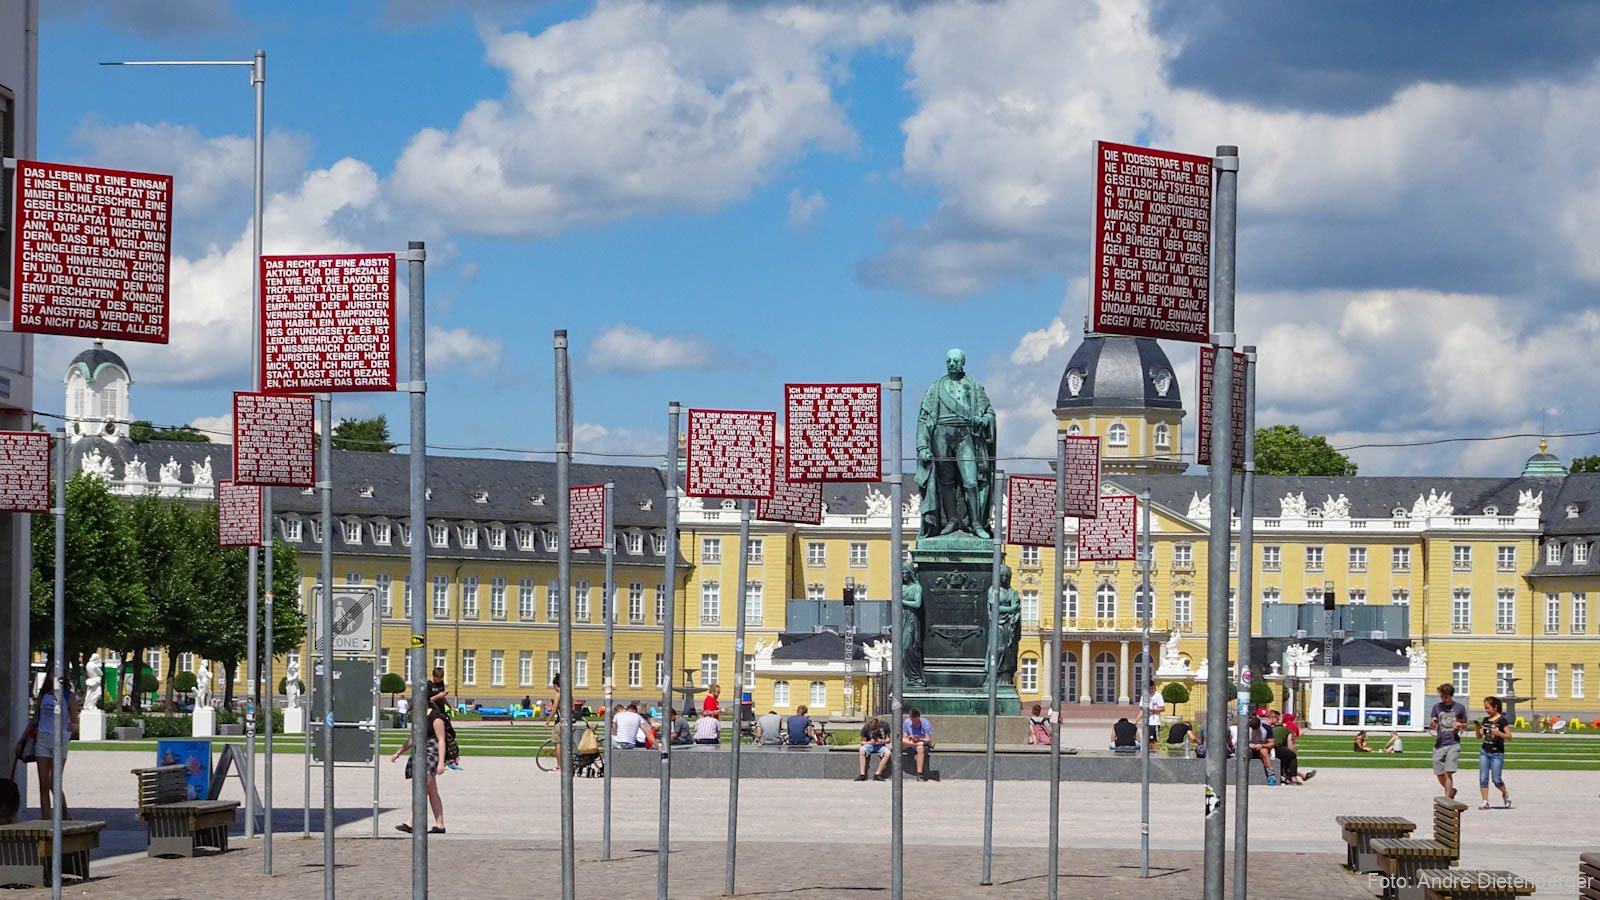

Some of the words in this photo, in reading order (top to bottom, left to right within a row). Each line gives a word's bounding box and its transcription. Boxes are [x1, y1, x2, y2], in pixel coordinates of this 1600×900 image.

[1104, 150, 1119, 161] DIE
[1124, 152, 1179, 170] TODESSTRAFE
[1182, 161, 1194, 172] IST
[1197, 163, 1210, 174] KEI
[24, 167, 46, 178] DAS
[48, 169, 82, 181] LEBEN
[85, 173, 100, 183] IST
[104, 175, 127, 186] EINE
[130, 177, 167, 190] EINSAM
[1104, 161, 1117, 172] NE
[1120, 164, 1158, 178] LEGITIME
[1161, 169, 1193, 183] STRAFE.
[1195, 174, 1209, 185] DER
[1104, 173, 1209, 197] GESELLSCHAFTSVERTRA
[24, 188, 56, 200] MMER
[57, 191, 75, 202] EIN
[76, 193, 143, 208] HILFESCHREI.
[145, 200, 167, 210] EINE
[24, 199, 106, 216] GESELLSCHAFT,
[110, 207, 127, 217] DIE
[131, 208, 152, 219] NUR
[156, 211, 167, 220] MI
[1103, 208, 1144, 222] UMFASST
[1148, 214, 1173, 228] NICHT,
[1176, 217, 1193, 229] DEM
[1196, 220, 1209, 231] STA
[23, 220, 50, 232] ANN,
[53, 222, 80, 233] DARF
[84, 225, 108, 236] SICH
[111, 228, 140, 239] NICHT
[144, 230, 166, 241] WUN
[23, 230, 56, 243] DERN,
[60, 234, 88, 245] DASS
[92, 236, 110, 246] IHR
[115, 238, 166, 251] VERLOREN
[22, 251, 62, 263] CHSEN.
[66, 255, 128, 270] HINWENDEN,
[133, 258, 166, 272] ZUHÖR
[302, 266, 321, 276] FÜR
[1102, 255, 1118, 266] EN.
[1121, 257, 1139, 269] DER
[1142, 259, 1166, 272] STAAT
[1170, 262, 1184, 274] HAT
[1188, 265, 1208, 276] DIESE
[22, 262, 38, 272] EN
[41, 263, 64, 274] UND
[68, 266, 129, 279] TOLERIEREN
[131, 269, 165, 282] GEHÖR
[22, 283, 114, 299] ERWIRTSCHAFTEN
[122, 289, 165, 303] KÖNNEN.
[22, 294, 46, 304] EINE
[51, 296, 101, 308] RESIDENZ
[106, 300, 127, 310] DES
[132, 302, 164, 313] RECHT
[335, 309, 390, 317] EMPFINDEN.
[1100, 302, 1162, 318] UNDAMENTALE
[1168, 306, 1207, 322] EINWÄNDE
[21, 304, 35, 314] S?
[39, 305, 96, 318] ANGSTFREI
[100, 310, 145, 323] WERDEN,
[148, 314, 164, 324] IST
[21, 314, 42, 325] DAS
[44, 316, 74, 327] NICHT
[78, 319, 99, 329] DAS
[102, 321, 121, 331] ZIEL
[127, 323, 164, 334] ALLER?
[337, 318, 390, 326] WUNDERBA
[1100, 314, 1130, 327] GEGEN
[1133, 317, 1146, 328] DIE
[1150, 319, 1207, 334] TODESSTRAFE.
[286, 327, 356, 335] GRUNDGESETZ.
[297, 368, 325, 378] LÄSST
[267, 379, 281, 388] EN,
[333, 638, 358, 648] ONE
